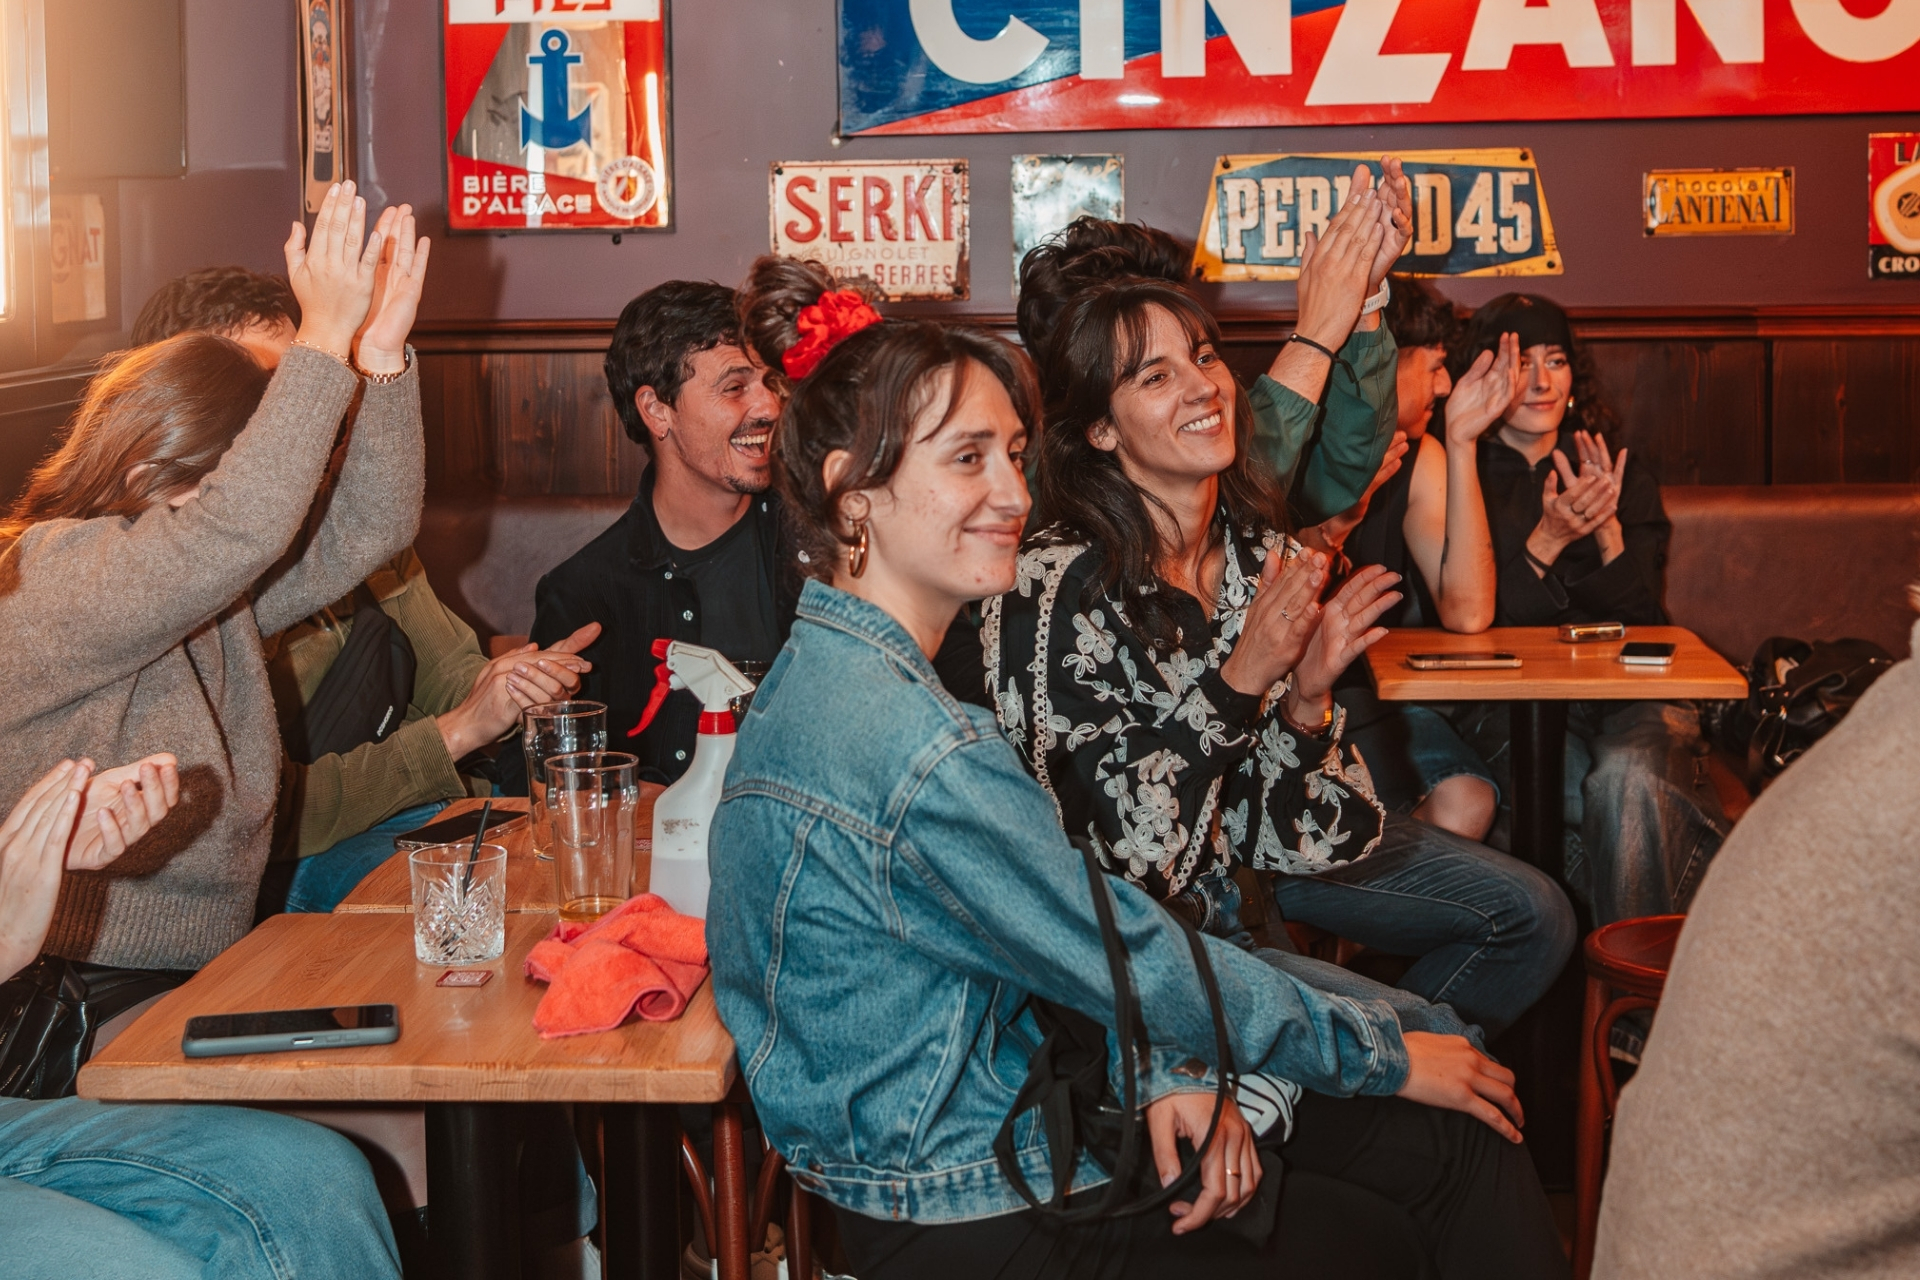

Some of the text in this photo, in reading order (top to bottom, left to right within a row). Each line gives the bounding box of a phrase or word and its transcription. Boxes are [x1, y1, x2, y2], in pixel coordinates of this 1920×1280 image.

[463, 170, 546, 193] BIÈRE
[463, 192, 592, 216] D'ALSACE
[1221, 171, 1532, 260] PERD 45
[874, 263, 953, 286] SERRES
[1878, 257, 1920, 273] CRO
